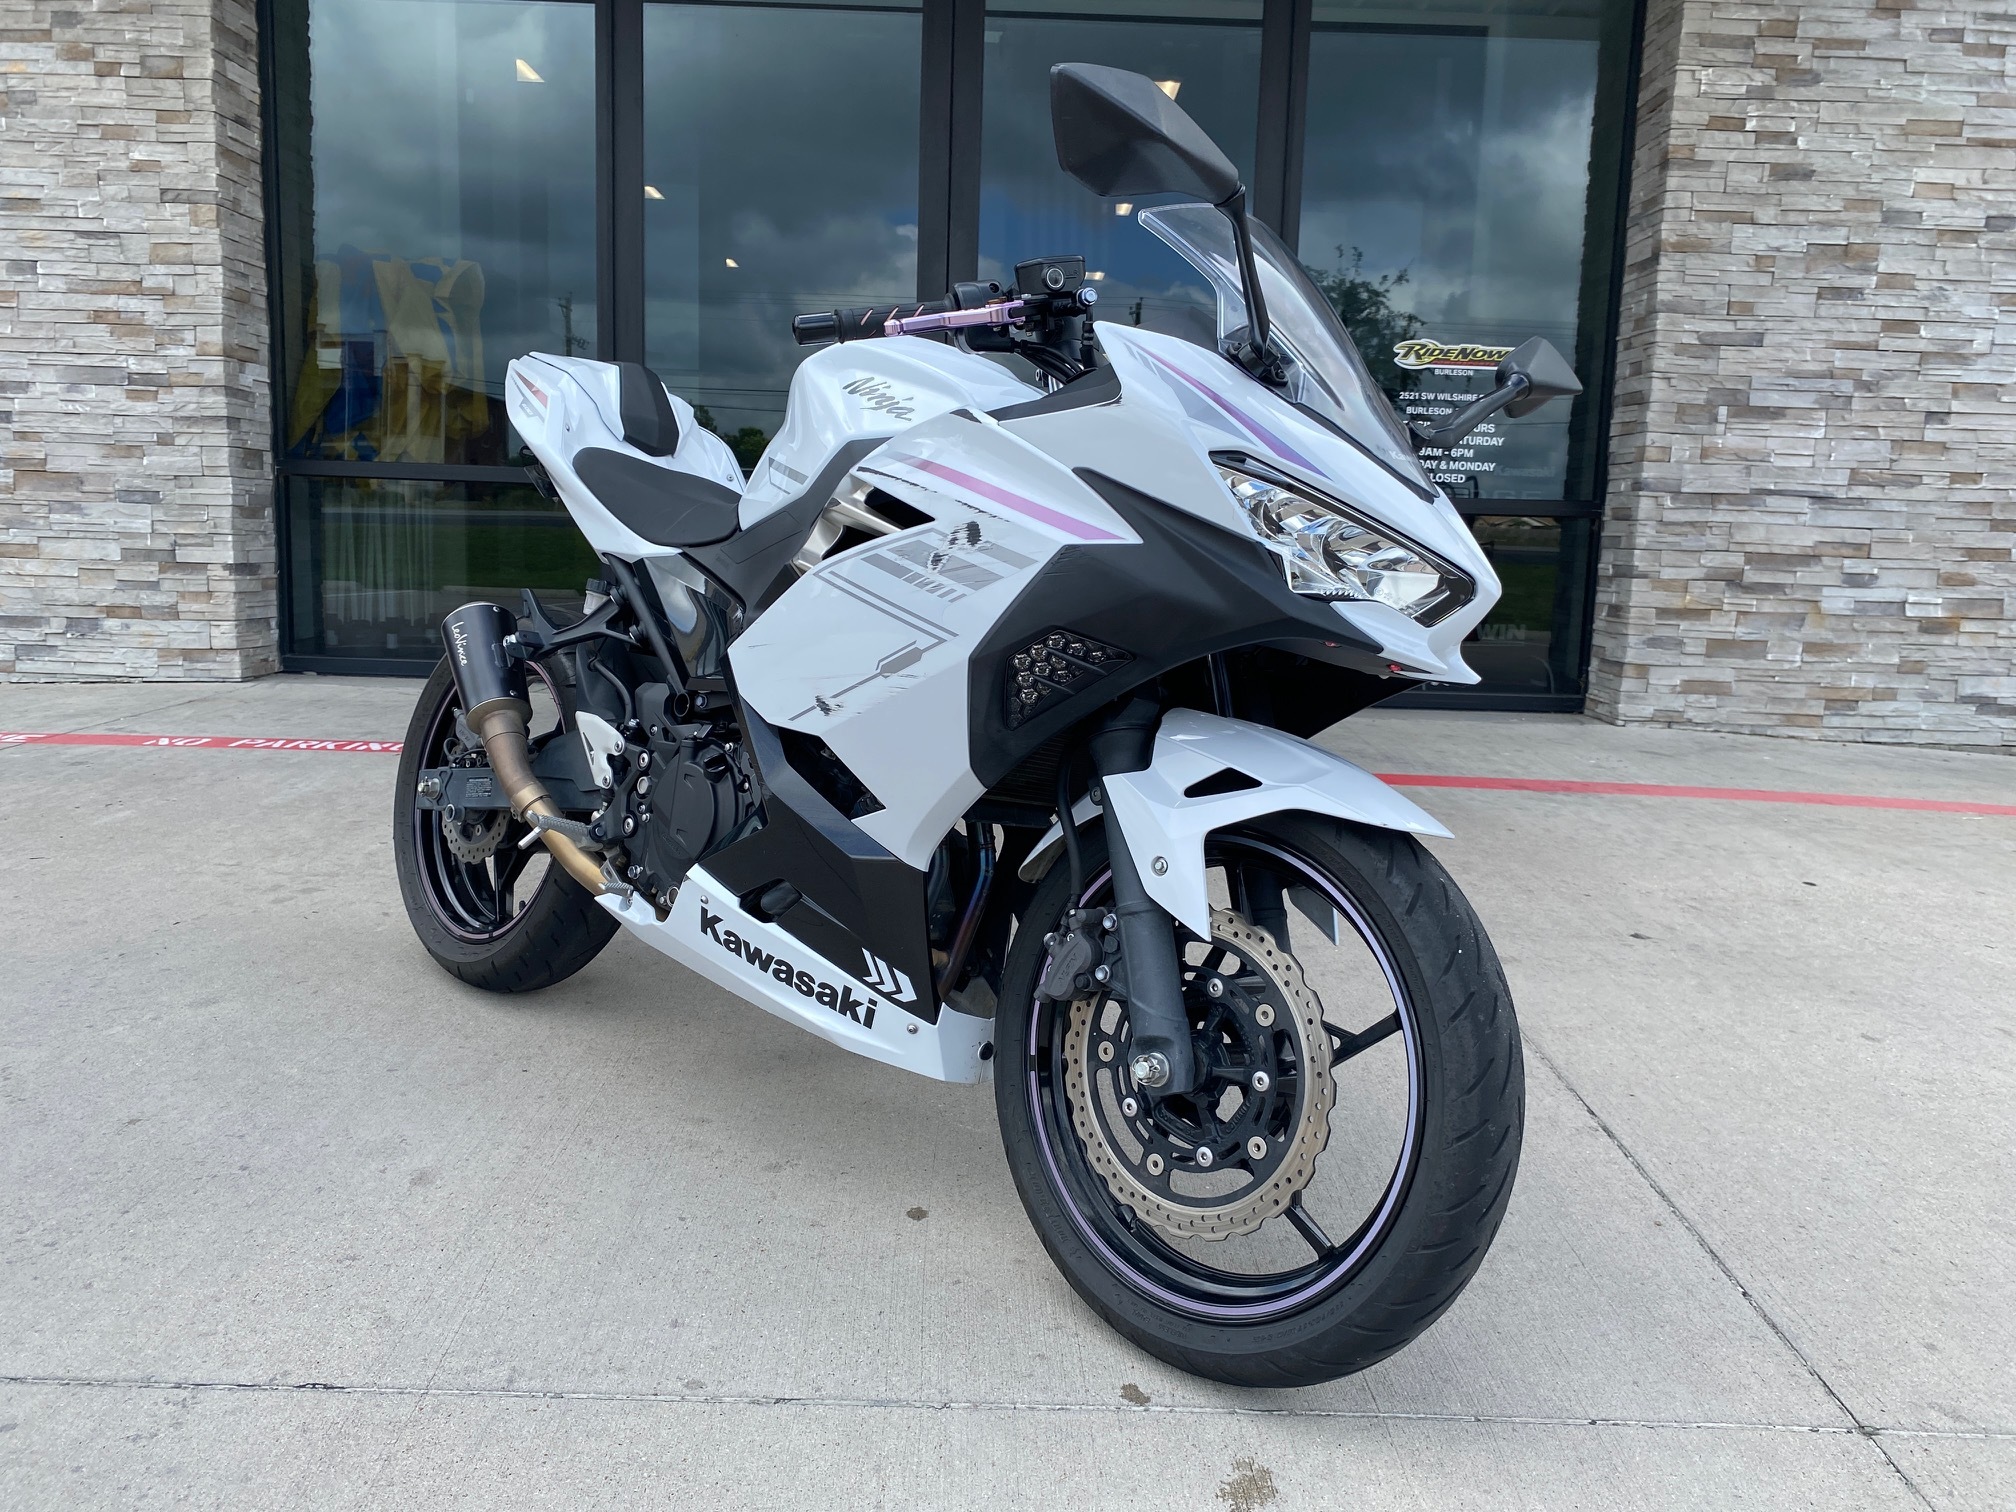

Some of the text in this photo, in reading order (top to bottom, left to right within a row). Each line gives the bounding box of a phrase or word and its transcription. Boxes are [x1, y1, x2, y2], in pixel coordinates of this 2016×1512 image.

[1434, 368, 1474, 376] BURLESON
[842, 376, 915, 421] Ninja
[1399, 392, 1419, 400] 2521
[1421, 392, 1436, 400] SW
[1406, 406, 1453, 415] BURLESON
[1459, 436, 1505, 446] TURDAY
[1450, 448, 1474, 458] 6PM
[1439, 460, 1448, 470] &
[1449, 461, 1496, 472] MONDAY
[1428, 472, 1466, 483] LOSED
[451, 621, 468, 667] LeoVince
[142, 737, 213, 747] NO
[700, 905, 878, 1030] Kawasaki
